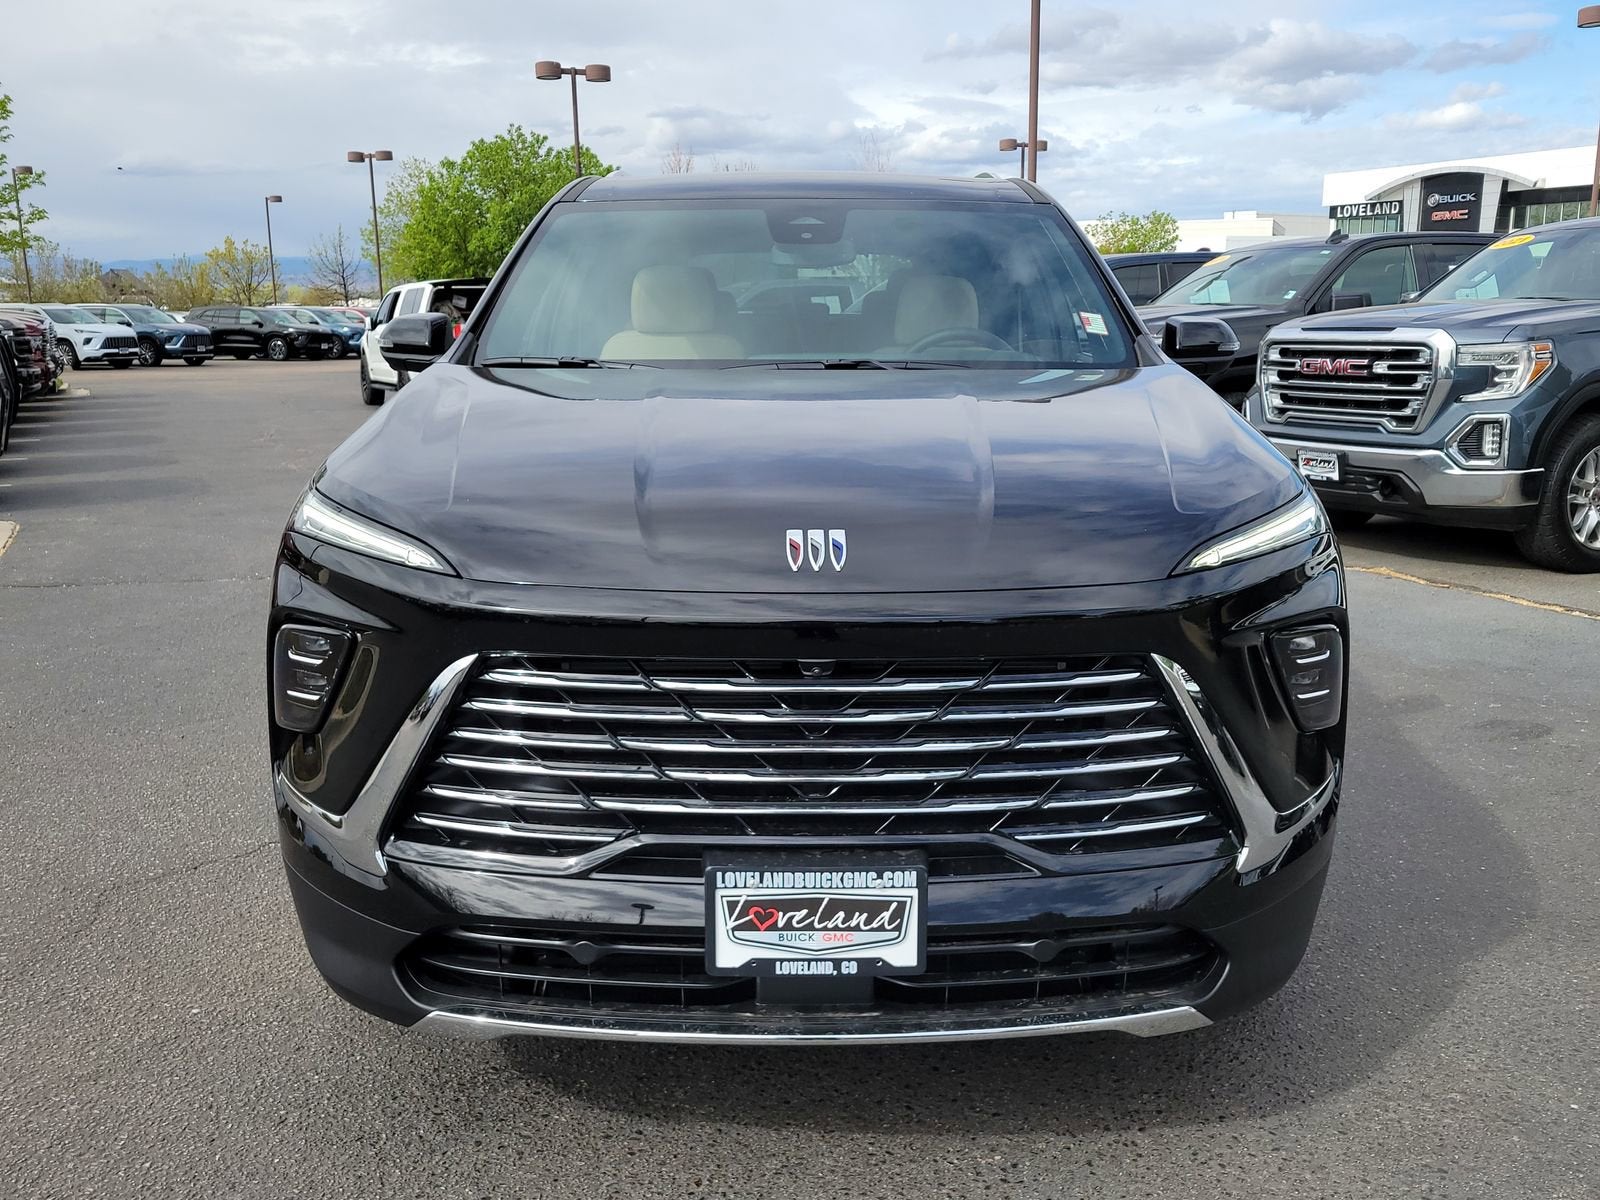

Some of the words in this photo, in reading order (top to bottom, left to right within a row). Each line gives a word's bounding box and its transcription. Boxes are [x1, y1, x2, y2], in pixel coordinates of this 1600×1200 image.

[1438, 193, 1477, 204] BUICK
[1337, 202, 1399, 218] LOVELAND
[1431, 209, 1469, 221] GMC
[1301, 358, 1368, 376] GMC
[716, 871, 917, 888] LOVELANDBUICKGMCCOM
[778, 932, 815, 942] BUICK
[822, 932, 854, 942] GMC
[775, 961, 837, 976] LOVELAND,
[841, 961, 858, 974] CO
